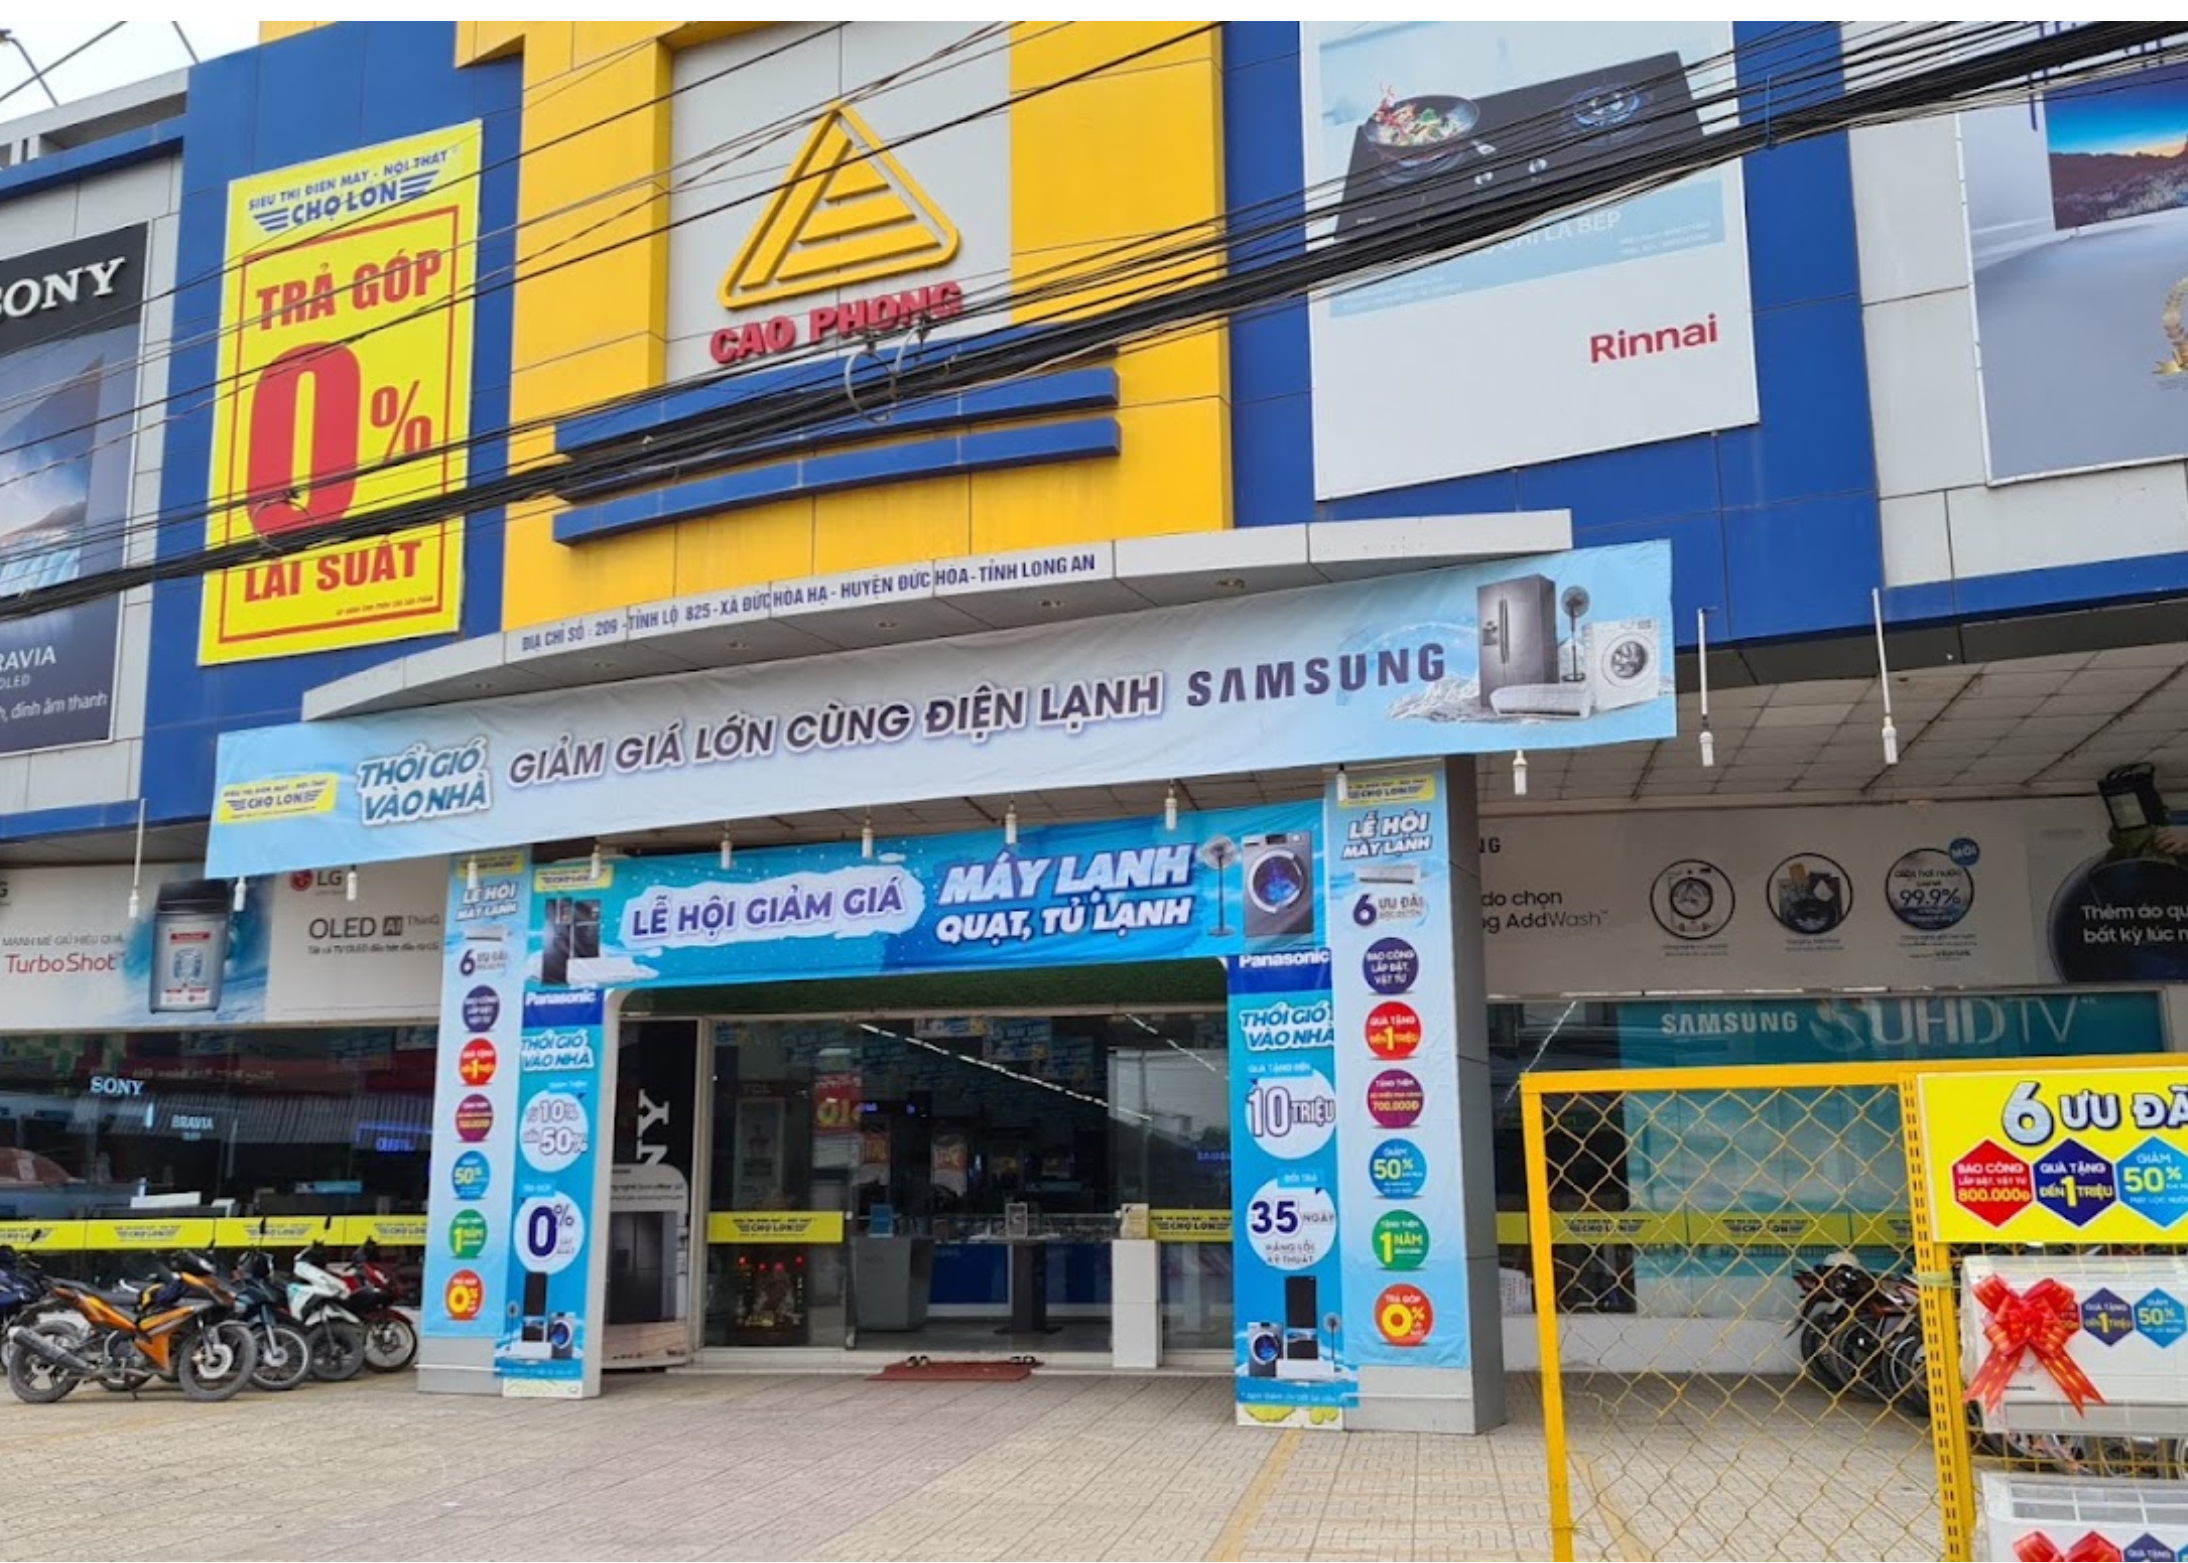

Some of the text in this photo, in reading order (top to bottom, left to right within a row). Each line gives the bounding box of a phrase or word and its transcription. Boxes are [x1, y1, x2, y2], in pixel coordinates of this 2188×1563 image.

[0, 256, 125, 318] ONY
[257, 249, 442, 331] TRẢ GÓP
[710, 280, 964, 364] CAO PHONG
[1590, 314, 1718, 363] Rinnai
[595, 618, 618, 637] 209
[686, 602, 711, 621] 825
[841, 575, 893, 600] HUYỆN
[898, 568, 930, 591] ĐỨC
[1022, 557, 1067, 577] LONG
[1071, 554, 1095, 572] AN
[509, 642, 1446, 783] GIẢM GIÁ LỚN CÙNG ĐIỆN LẠNH SAMSUNG
[360, 737, 485, 787] THỔI GIÓ
[364, 787, 423, 821] VÀO
[426, 773, 487, 812] NHÀ
[317, 870, 342, 886] LG
[939, 845, 1196, 904] MÁY LẠNH
[633, 876, 902, 937] LỄ HỘI GIẢM GIÁ
[1353, 893, 1377, 927] 6
[1512, 890, 1563, 910] chọn
[1900, 888, 1961, 905] 99.9%
[1041, 896, 1085, 936] TỦ
[1094, 898, 1192, 937] LẠNH
[2081, 903, 2134, 920] Thêm
[2138, 903, 2163, 918] áo
[309, 917, 376, 939] OLED
[2083, 925, 2117, 943] bất
[2146, 926, 2174, 941] lúc
[460, 949, 476, 977] 6
[1239, 950, 1330, 968] Panasonic
[525, 990, 596, 1006] Panasonic
[1291, 1001, 1328, 1024] GIÓ
[1662, 1012, 1798, 1034] SAMSUNG
[1248, 1025, 1290, 1048] VÀO
[1384, 1026, 1394, 1051] 1
[91, 1076, 143, 1096] SONY
[171, 1114, 214, 1131] BRAVIA
[1246, 1086, 1336, 1137] 10 TRIỆU
[2002, 1081, 2055, 1147] 6
[2059, 1089, 2122, 1131] ƯU
[1957, 1160, 2024, 1174] BAO CÔNG
[2040, 1161, 2106, 1177] QUÀ TẶNG
[2136, 1151, 2172, 1164] GIẢM
[2040, 1175, 2113, 1208] ĐẾN 1 TRIỆU
[2124, 1165, 2183, 1194] 50%
[1251, 1201, 1298, 1233] 35
[1379, 1231, 1393, 1263] 1
[2098, 1312, 2109, 1333] 1
